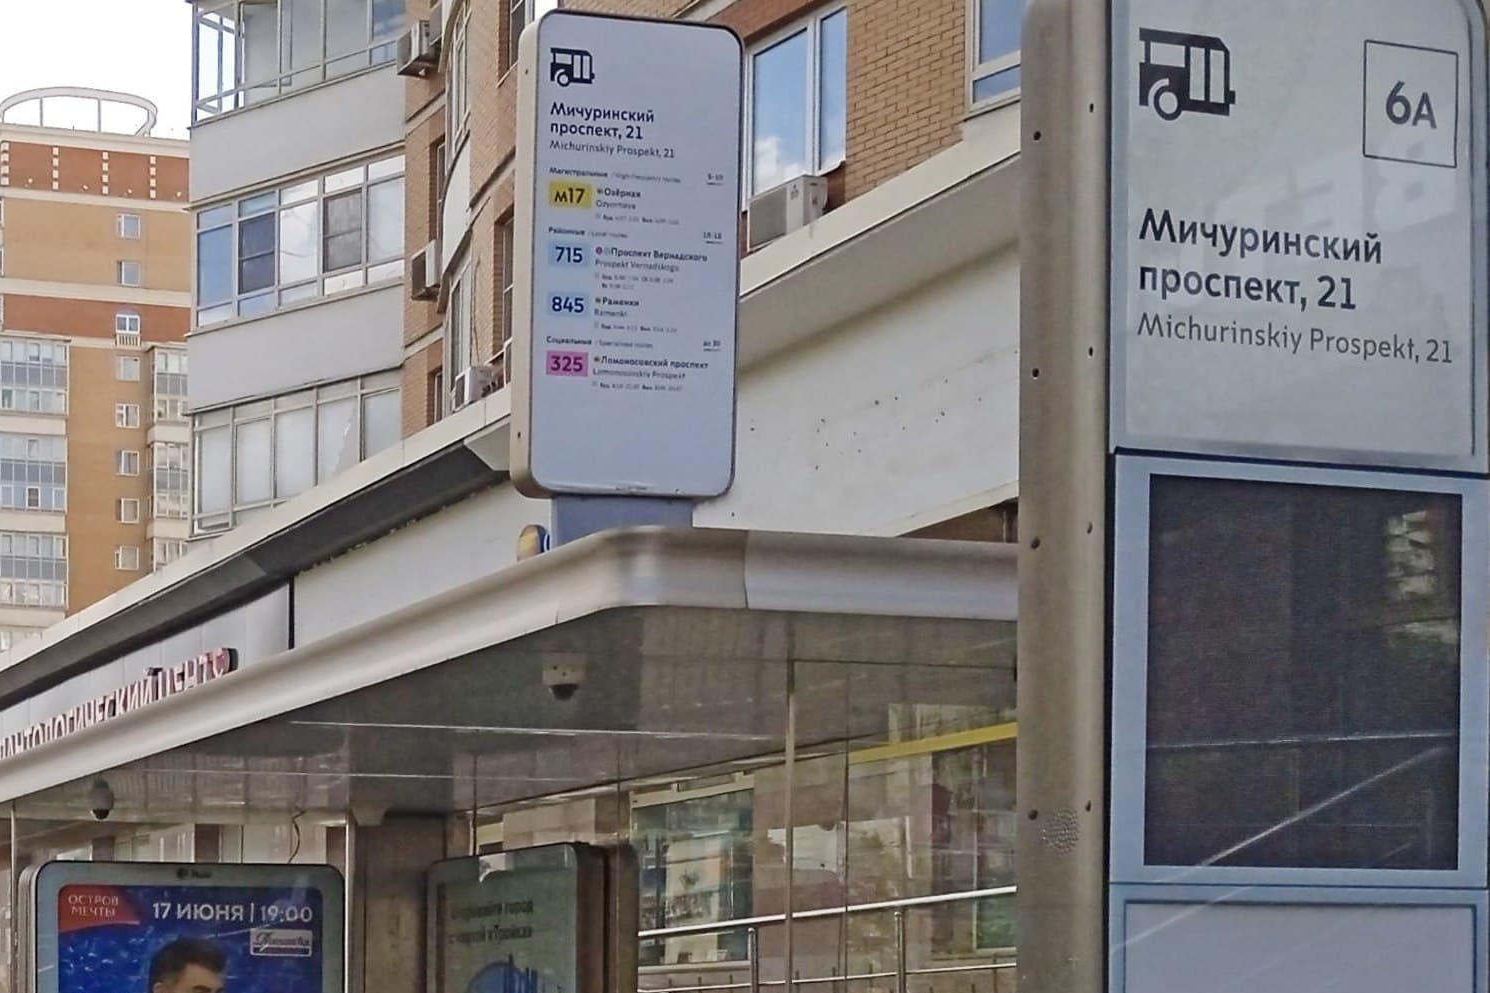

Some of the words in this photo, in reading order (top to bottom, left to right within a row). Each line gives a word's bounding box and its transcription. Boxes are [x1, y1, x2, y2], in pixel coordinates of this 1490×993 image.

[550, 102, 655, 123] Мичуринский
[550, 121, 622, 140] проспект,
[626, 125, 643, 140] 21
[549, 140, 614, 155] Michurinskiy
[663, 148, 675, 159] 21
[1139, 208, 1382, 264] Мичуринский
[555, 246, 583, 263] 715
[611, 247, 651, 259] Проспект
[653, 250, 708, 262] Вернадского
[1139, 266, 1307, 312] проспект,
[1317, 276, 1357, 310] 21
[552, 296, 585, 313] 845
[602, 297, 640, 307] Раменки
[1137, 312, 1302, 354] Michurinskiy
[1310, 328, 1420, 364] Prospekt,
[1426, 339, 1453, 364] 21
[551, 355, 583, 373] 325
[600, 356, 668, 368] Ломоносовский
[670, 359, 709, 370] проспект
[68, 895, 119, 906] ОСТРОВ
[71, 906, 116, 917] МЕЧТЫ
[152, 903, 171, 919] 17
[177, 904, 244, 921] ИЮНЯ
[261, 905, 313, 923] 19:00
